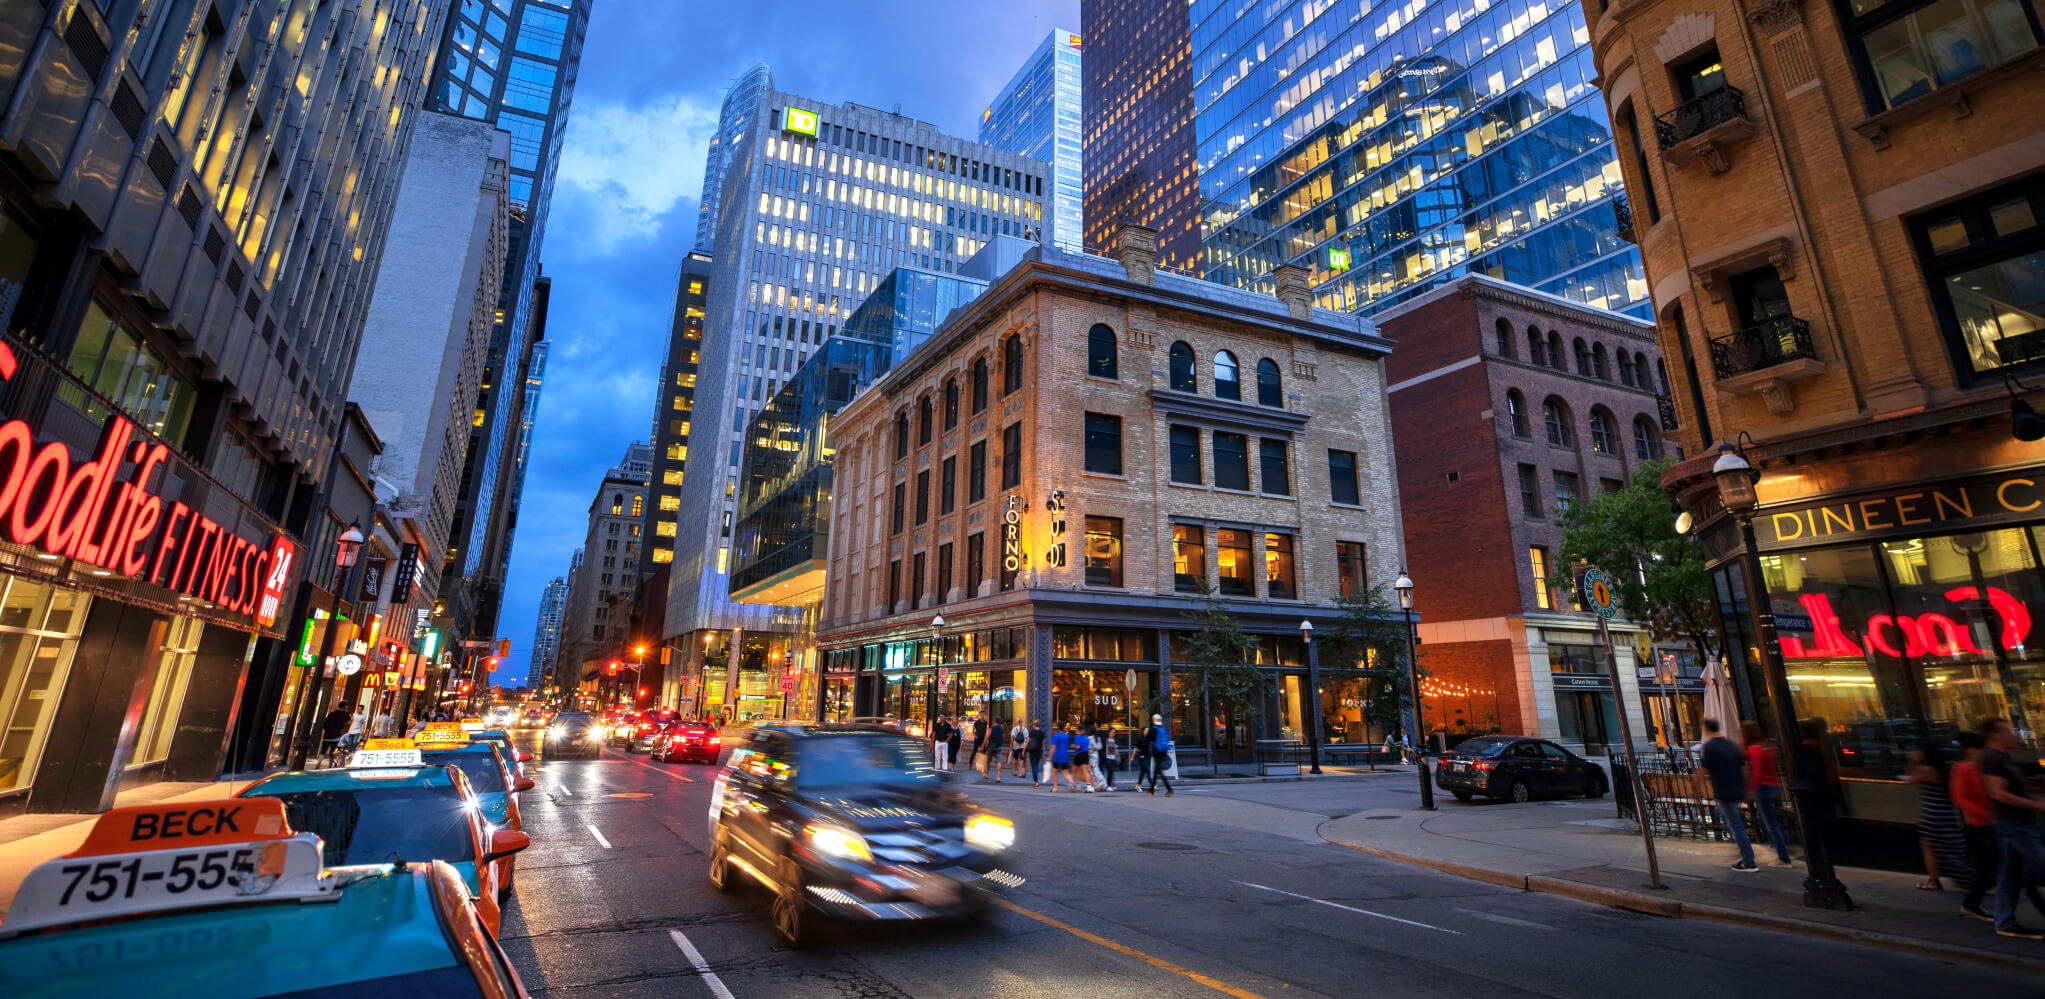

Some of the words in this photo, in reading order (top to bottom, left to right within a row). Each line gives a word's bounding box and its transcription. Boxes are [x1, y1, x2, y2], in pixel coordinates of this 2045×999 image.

[790, 111, 815, 131] TD
[0, 340, 168, 577] oodLife
[151, 501, 268, 615] FITNESS
[1005, 494, 1019, 571] FORNO
[1051, 488, 1063, 569] SUD
[1772, 486, 1975, 542] DINEEN
[267, 547, 292, 593] 24
[1094, 695, 1118, 705] SUD
[421, 731, 462, 741] 751-5555
[360, 752, 415, 765] 751-5555
[130, 806, 243, 842] BECK
